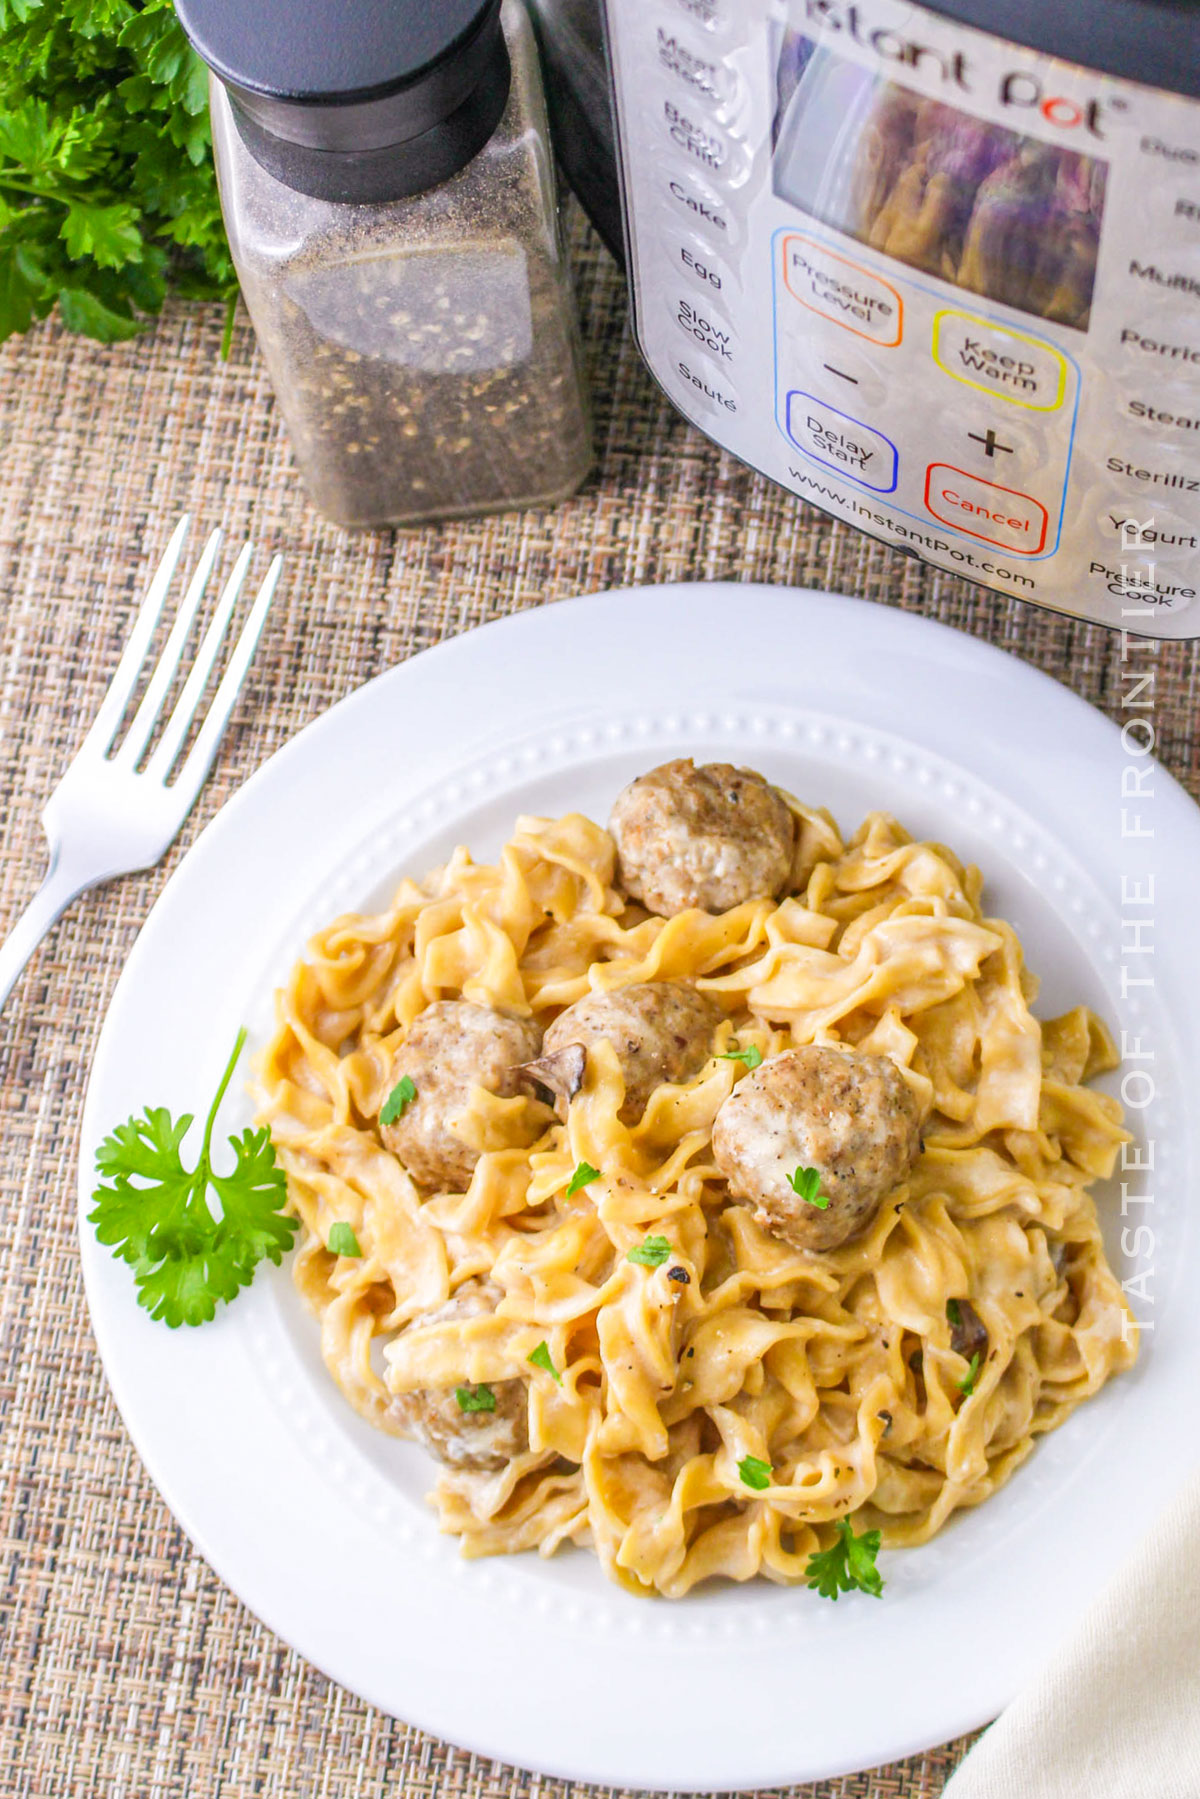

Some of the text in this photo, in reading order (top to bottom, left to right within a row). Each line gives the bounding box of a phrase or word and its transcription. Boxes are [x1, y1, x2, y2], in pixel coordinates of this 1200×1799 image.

[669, 182, 727, 230] Cake
[680, 248, 722, 289] Egg
[792, 253, 893, 316] Pressure
[679, 300, 730, 344] Slow
[811, 282, 872, 322] Level
[677, 313, 733, 362] Cook
[964, 337, 1035, 376] Keep
[678, 362, 737, 413] Sauté
[959, 350, 1038, 392] Warm
[806, 415, 874, 461] Delay
[813, 433, 867, 472] Start
[788, 466, 1036, 589] www.InstantPot.com
[941, 489, 1030, 532] Cancel
[1108, 514, 1197, 549] Yogurt
[1089, 561, 1197, 599] Pressure
[1106, 582, 1174, 608] Cook
